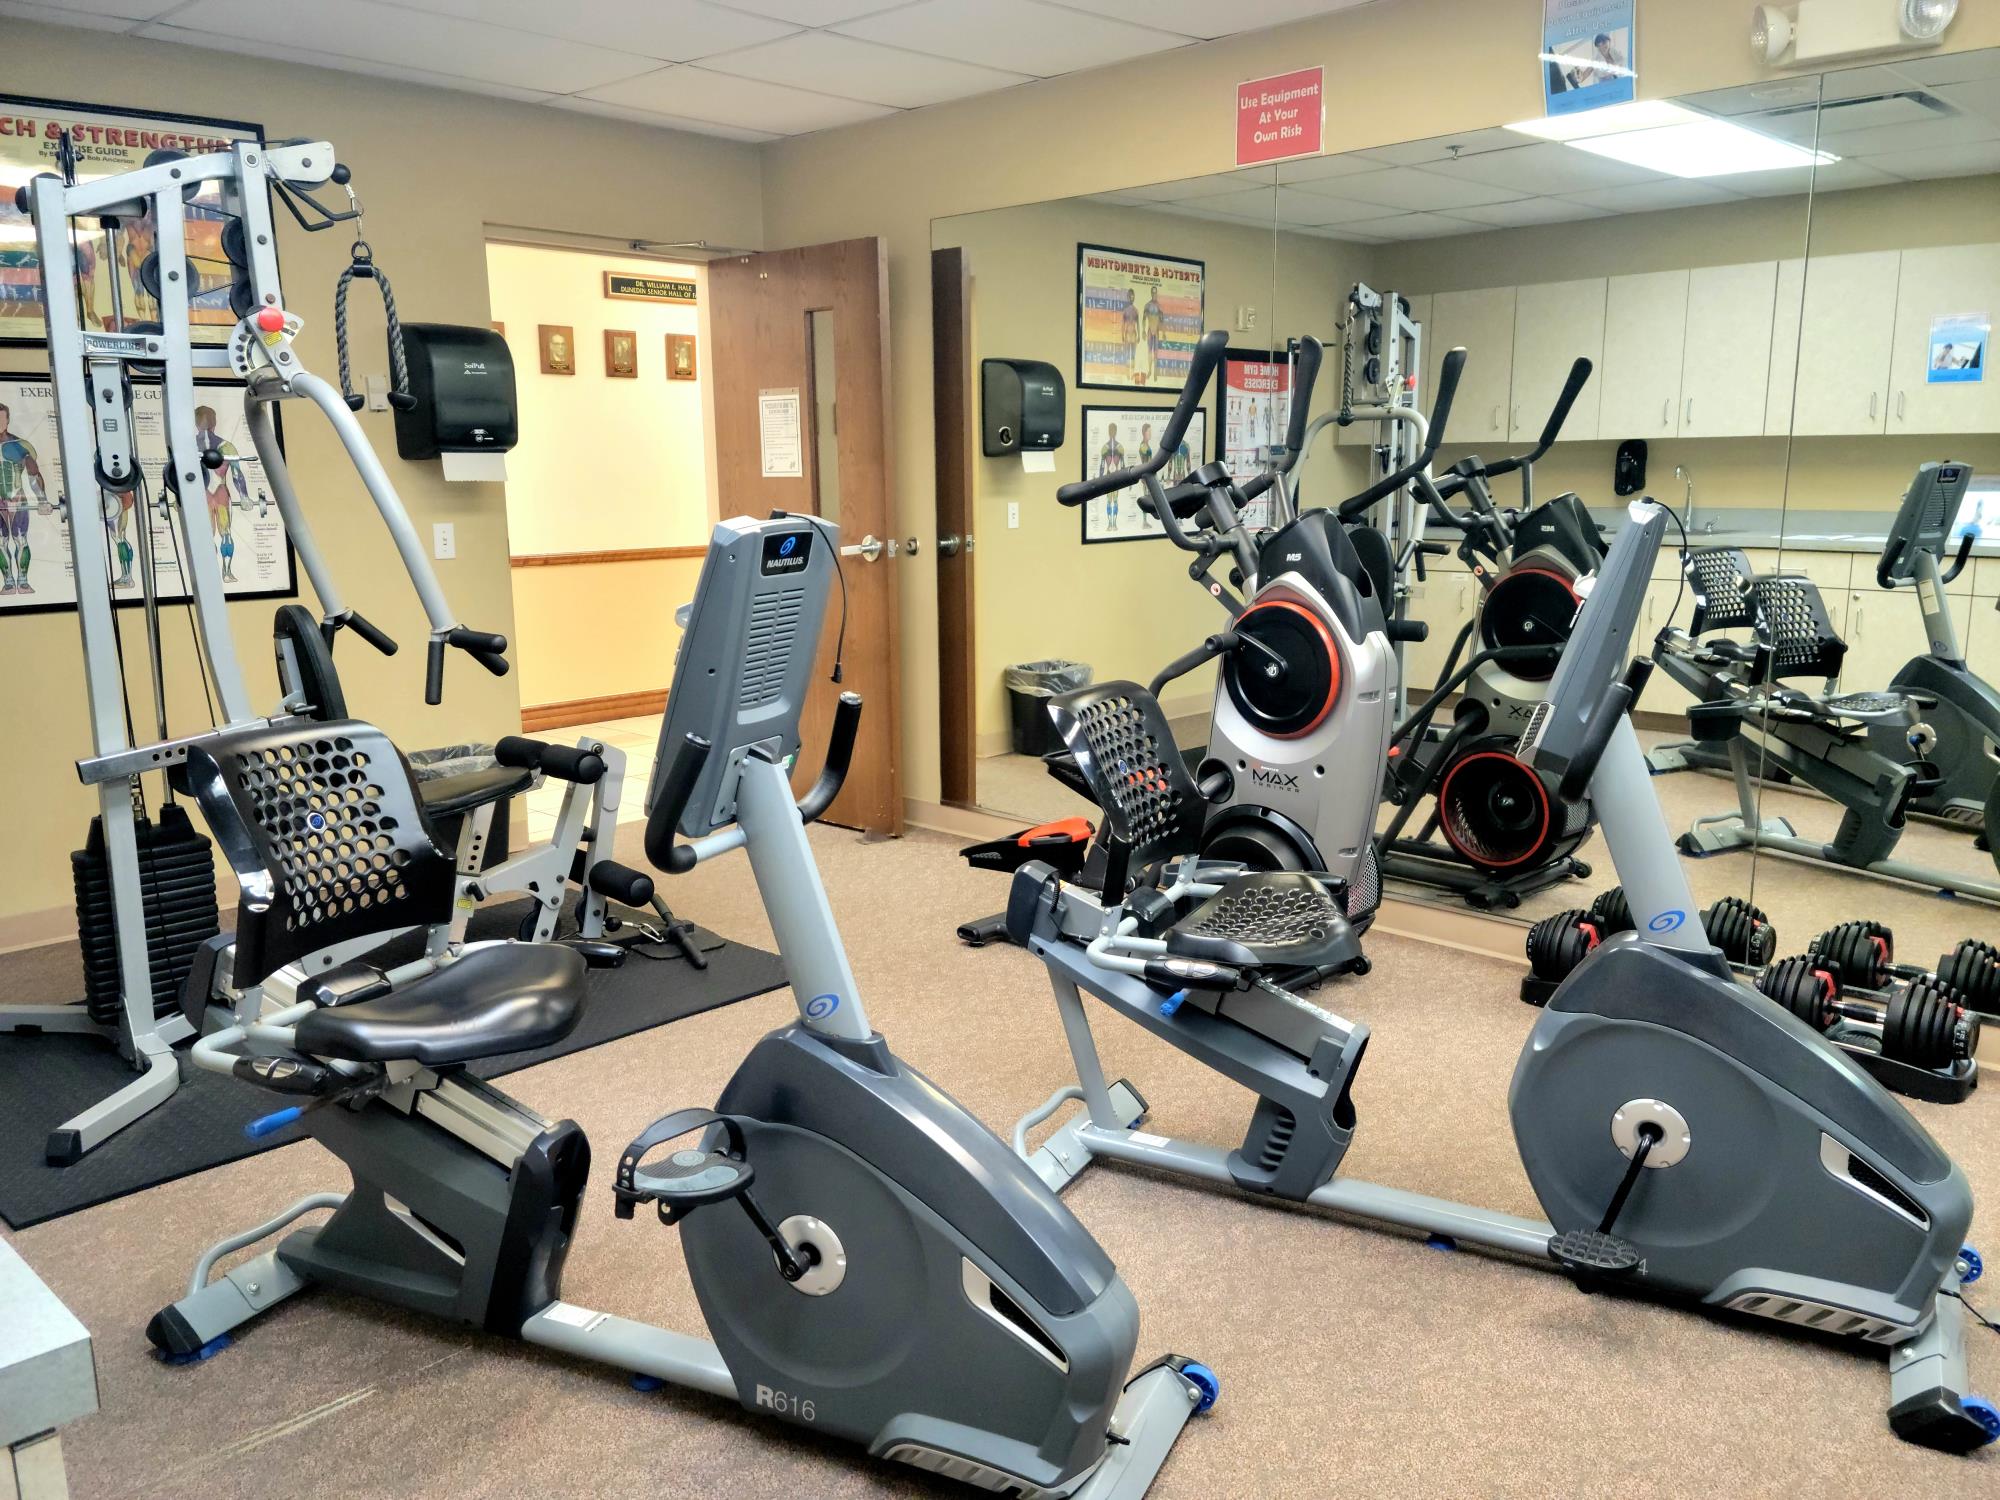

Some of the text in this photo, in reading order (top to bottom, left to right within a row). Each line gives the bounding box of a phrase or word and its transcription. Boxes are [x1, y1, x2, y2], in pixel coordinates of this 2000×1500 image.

[1240, 83, 1319, 110] Use Equipment
[1259, 108, 1298, 125] At Your
[0, 117, 225, 154] CH & STRENGTH
[1254, 124, 1302, 144] Own Risk
[43, 142, 128, 156] EXISE GUIDE
[620, 286, 646, 294] DUNEDIN
[647, 288, 667, 296] SENIOR
[646, 281, 670, 290] WILLIAM
[86, 339, 142, 351] POWERLINE
[20, 387, 53, 398] EXER
[766, 557, 804, 568] NAUTILUS
[1286, 553, 1302, 561] M5
[1252, 768, 1298, 787] MAX
[756, 1383, 816, 1421] R616
